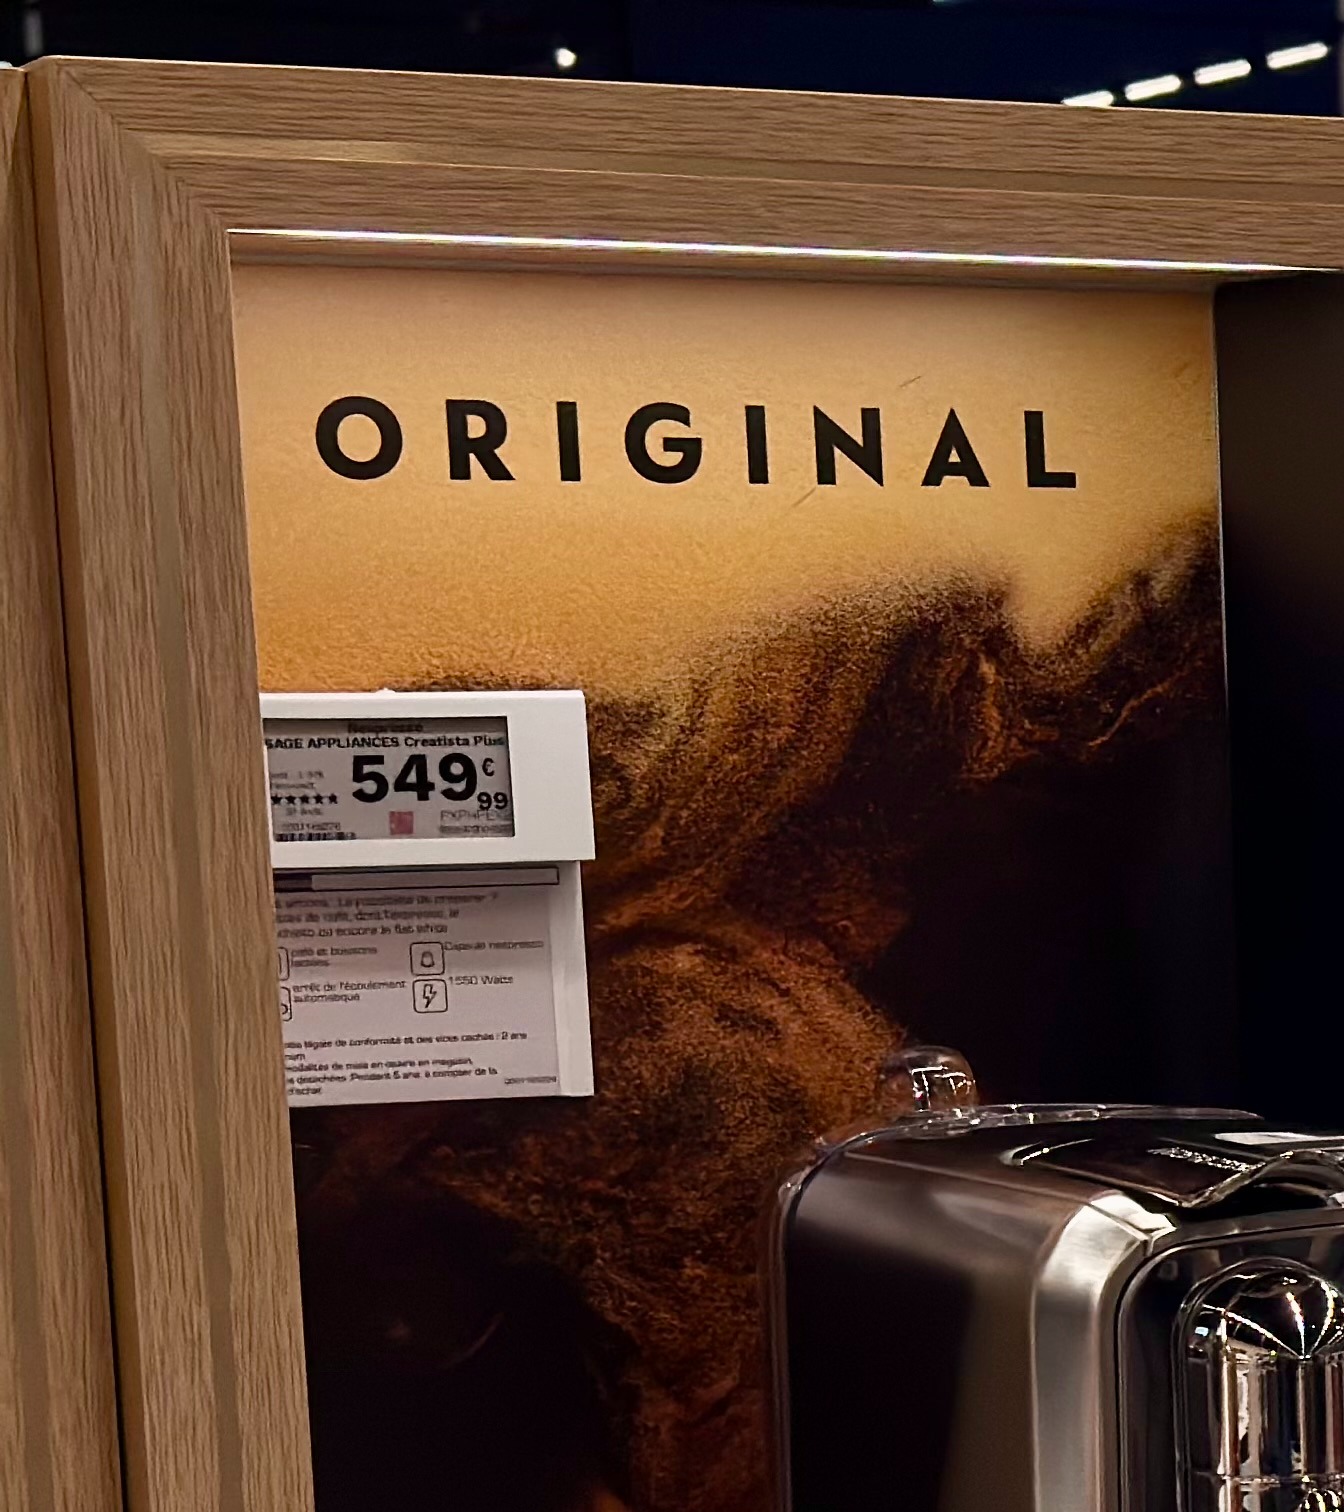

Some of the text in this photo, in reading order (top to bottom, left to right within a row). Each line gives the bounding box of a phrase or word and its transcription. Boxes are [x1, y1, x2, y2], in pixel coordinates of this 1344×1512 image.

[314, 395, 1078, 489] ORIGINAL
[265, 738, 304, 750] SAGE
[307, 736, 400, 749] APPLIANCES
[404, 736, 470, 748] Creatista
[351, 752, 509, 811] 549 € 99
